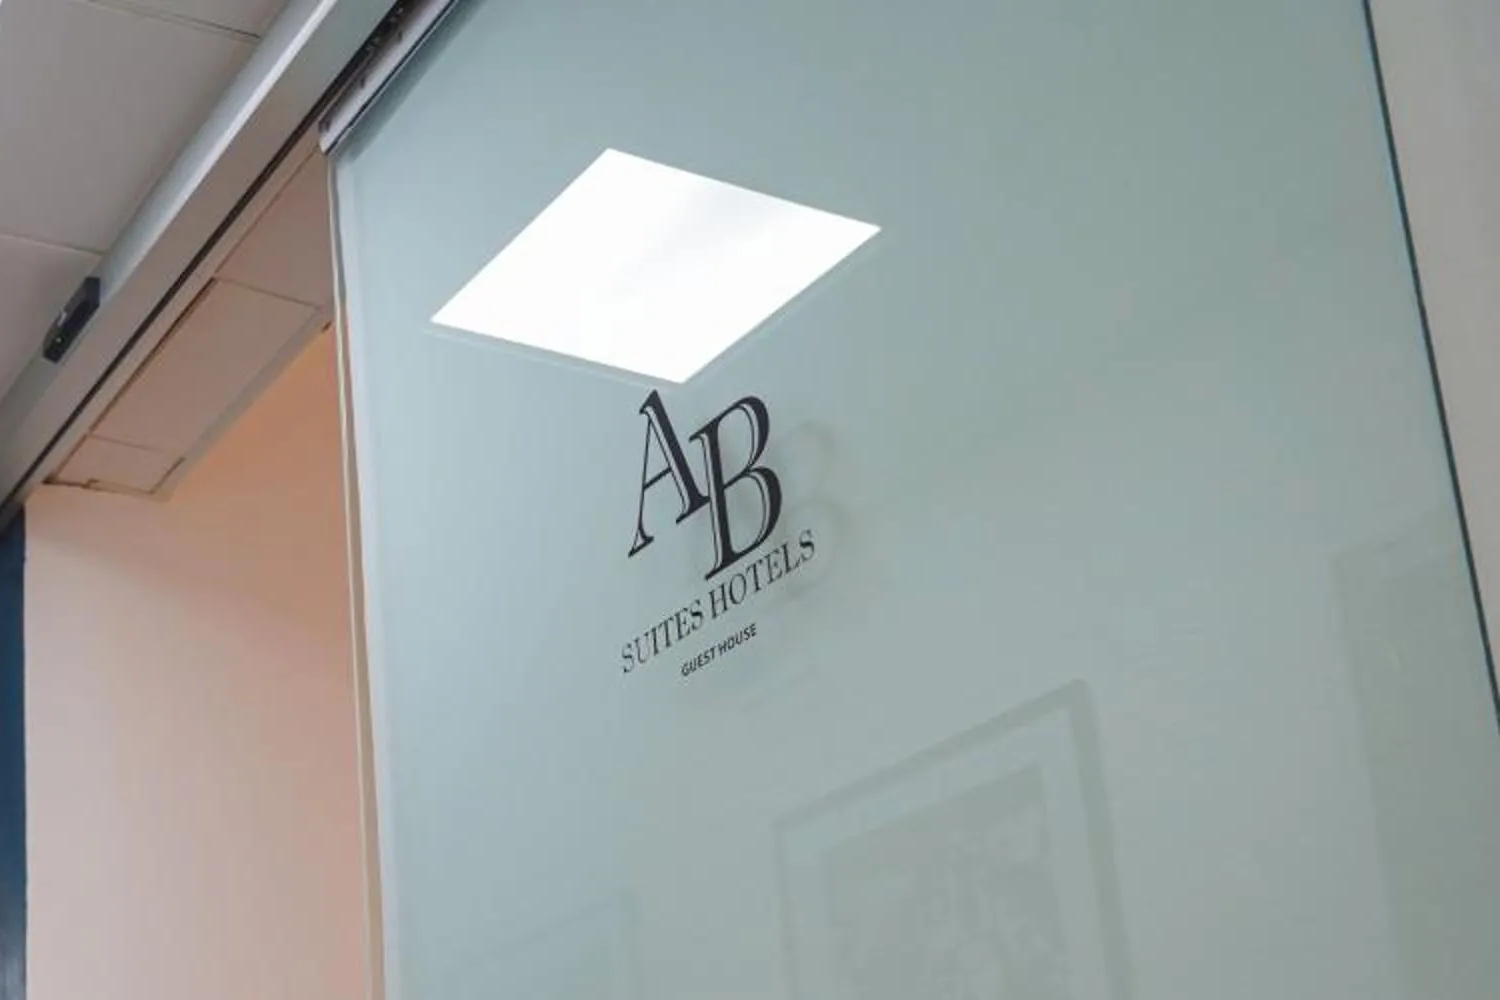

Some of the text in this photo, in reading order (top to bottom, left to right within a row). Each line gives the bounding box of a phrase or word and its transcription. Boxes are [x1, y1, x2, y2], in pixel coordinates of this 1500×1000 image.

[628, 389, 782, 581] AB
[621, 529, 815, 673] SUITES HOTELS
[681, 623, 757, 676] GUEST HOUSE
